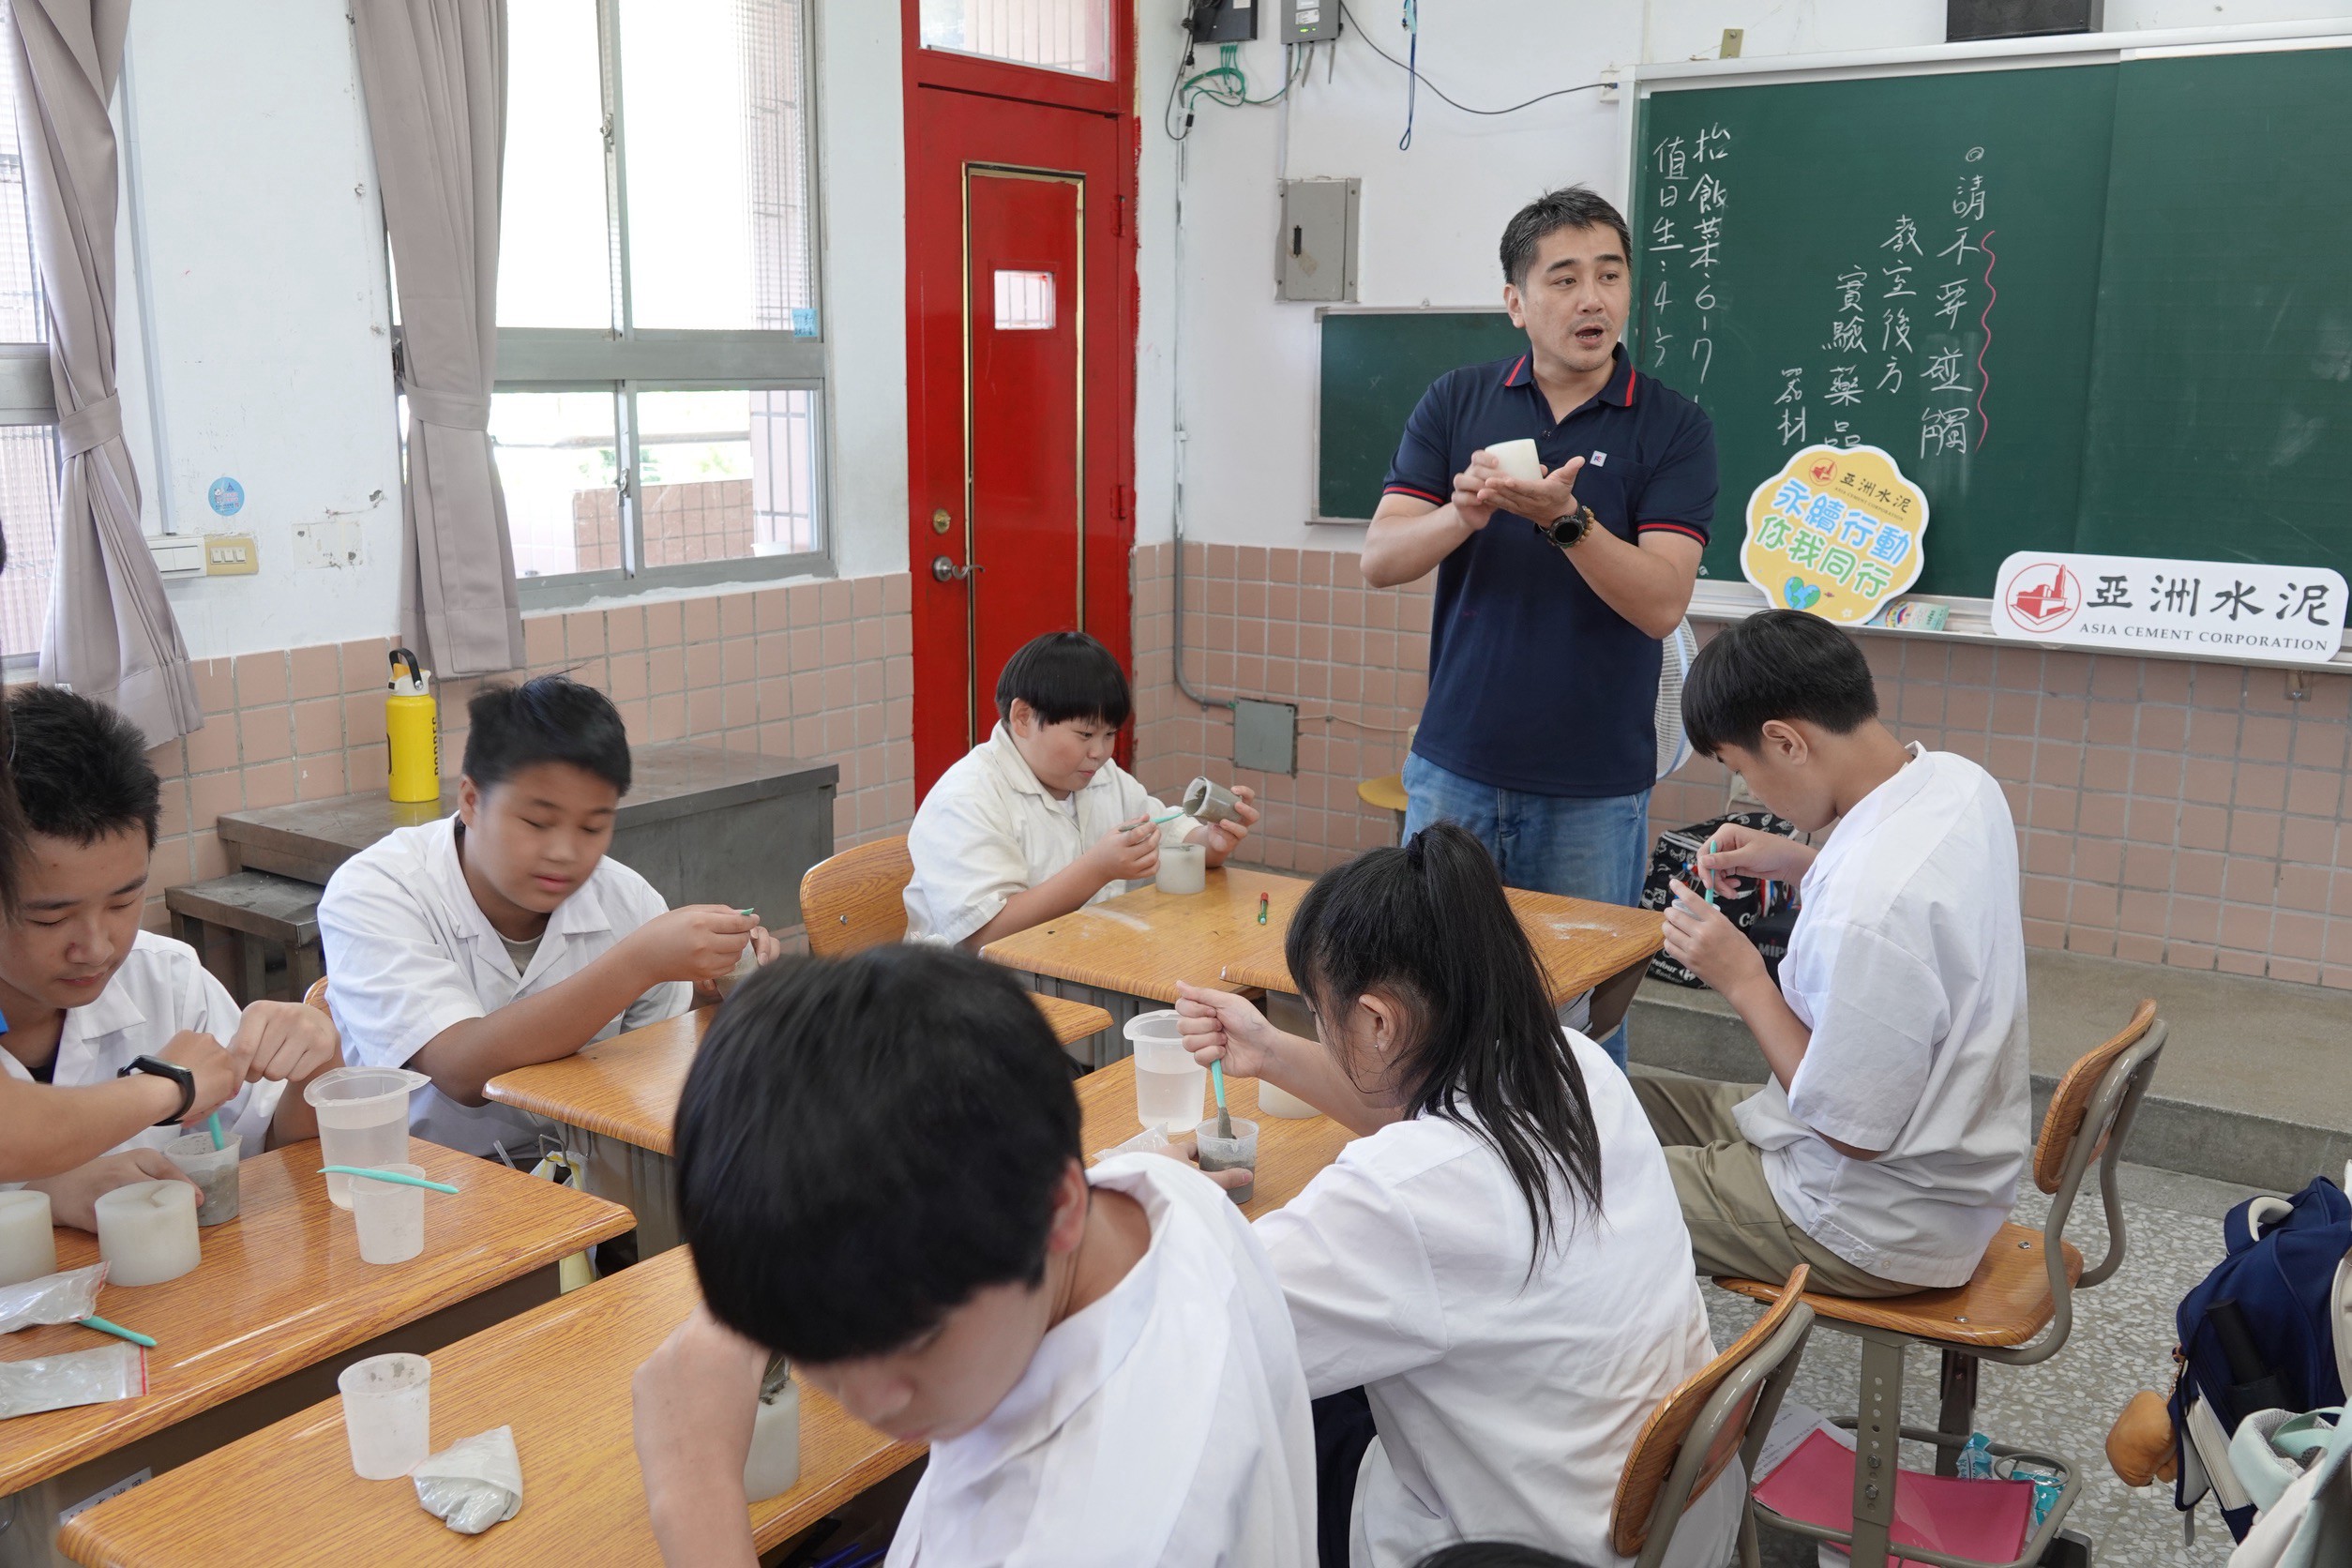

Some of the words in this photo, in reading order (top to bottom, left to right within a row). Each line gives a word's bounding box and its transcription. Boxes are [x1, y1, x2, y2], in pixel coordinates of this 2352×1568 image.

[1877, 214, 1923, 394] 教室後方
[1821, 264, 1868, 446] 實驗藥品
[1773, 479, 1911, 565] 永續行動
[1840, 472, 1911, 514] 亞洲水泥
[1756, 516, 1892, 598] 你我同行
[2079, 623, 2118, 636] ASIA
[2124, 626, 2194, 641] CEMENT
[2198, 631, 2329, 651] CORPORATION
[2087, 574, 2330, 626] 亞洲水泥
